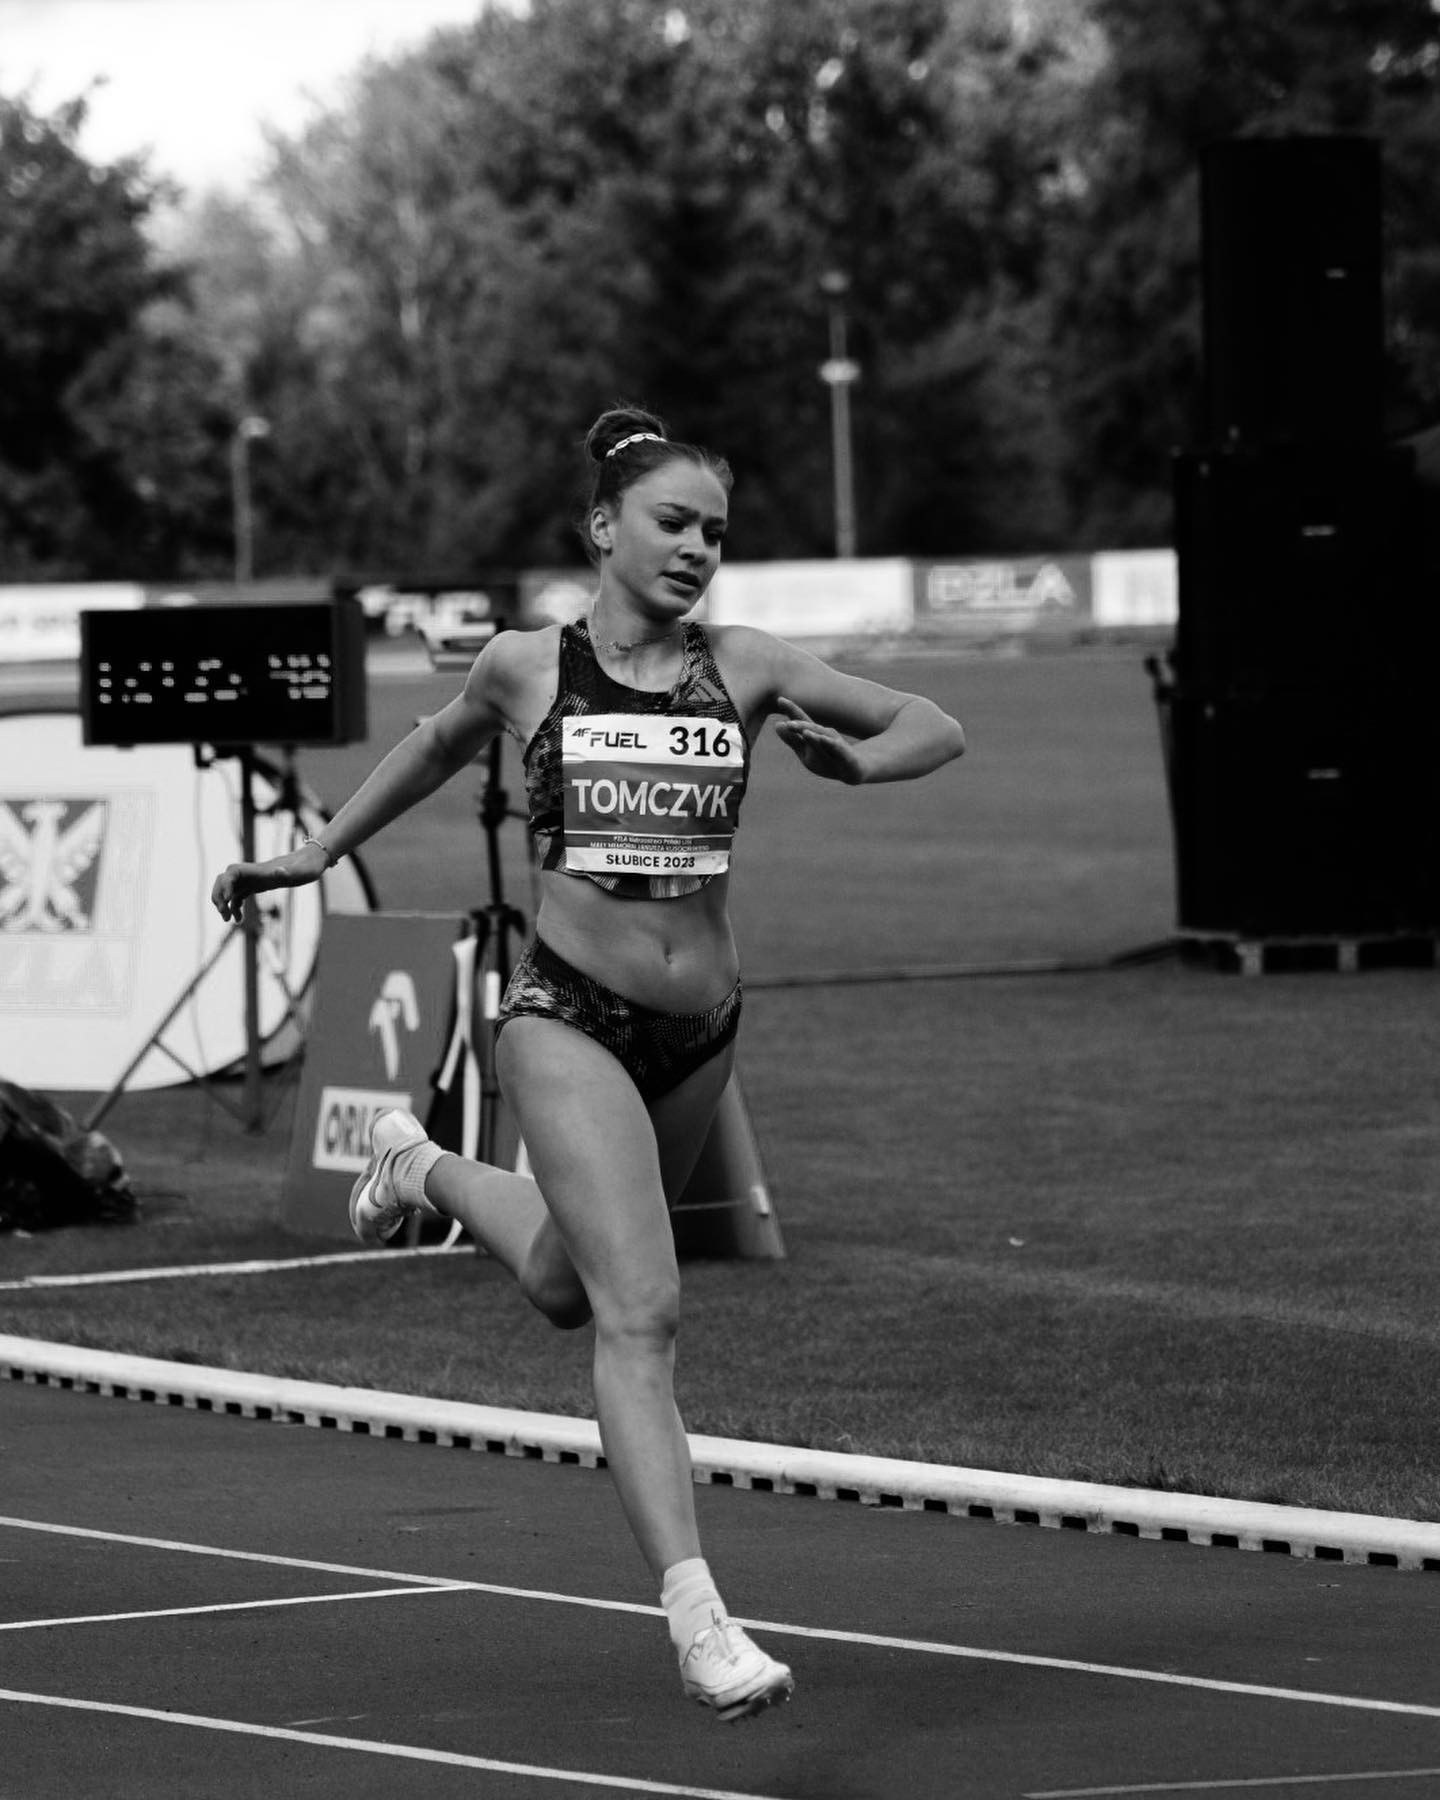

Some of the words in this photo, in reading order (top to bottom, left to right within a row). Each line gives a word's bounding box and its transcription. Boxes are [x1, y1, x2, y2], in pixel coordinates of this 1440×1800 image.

[589, 731, 648, 749] FUEL
[669, 726, 731, 757] 316
[571, 778, 735, 819] TOMCZYK
[605, 853, 660, 868] SŁUBICE
[663, 856, 696, 868] 2023
